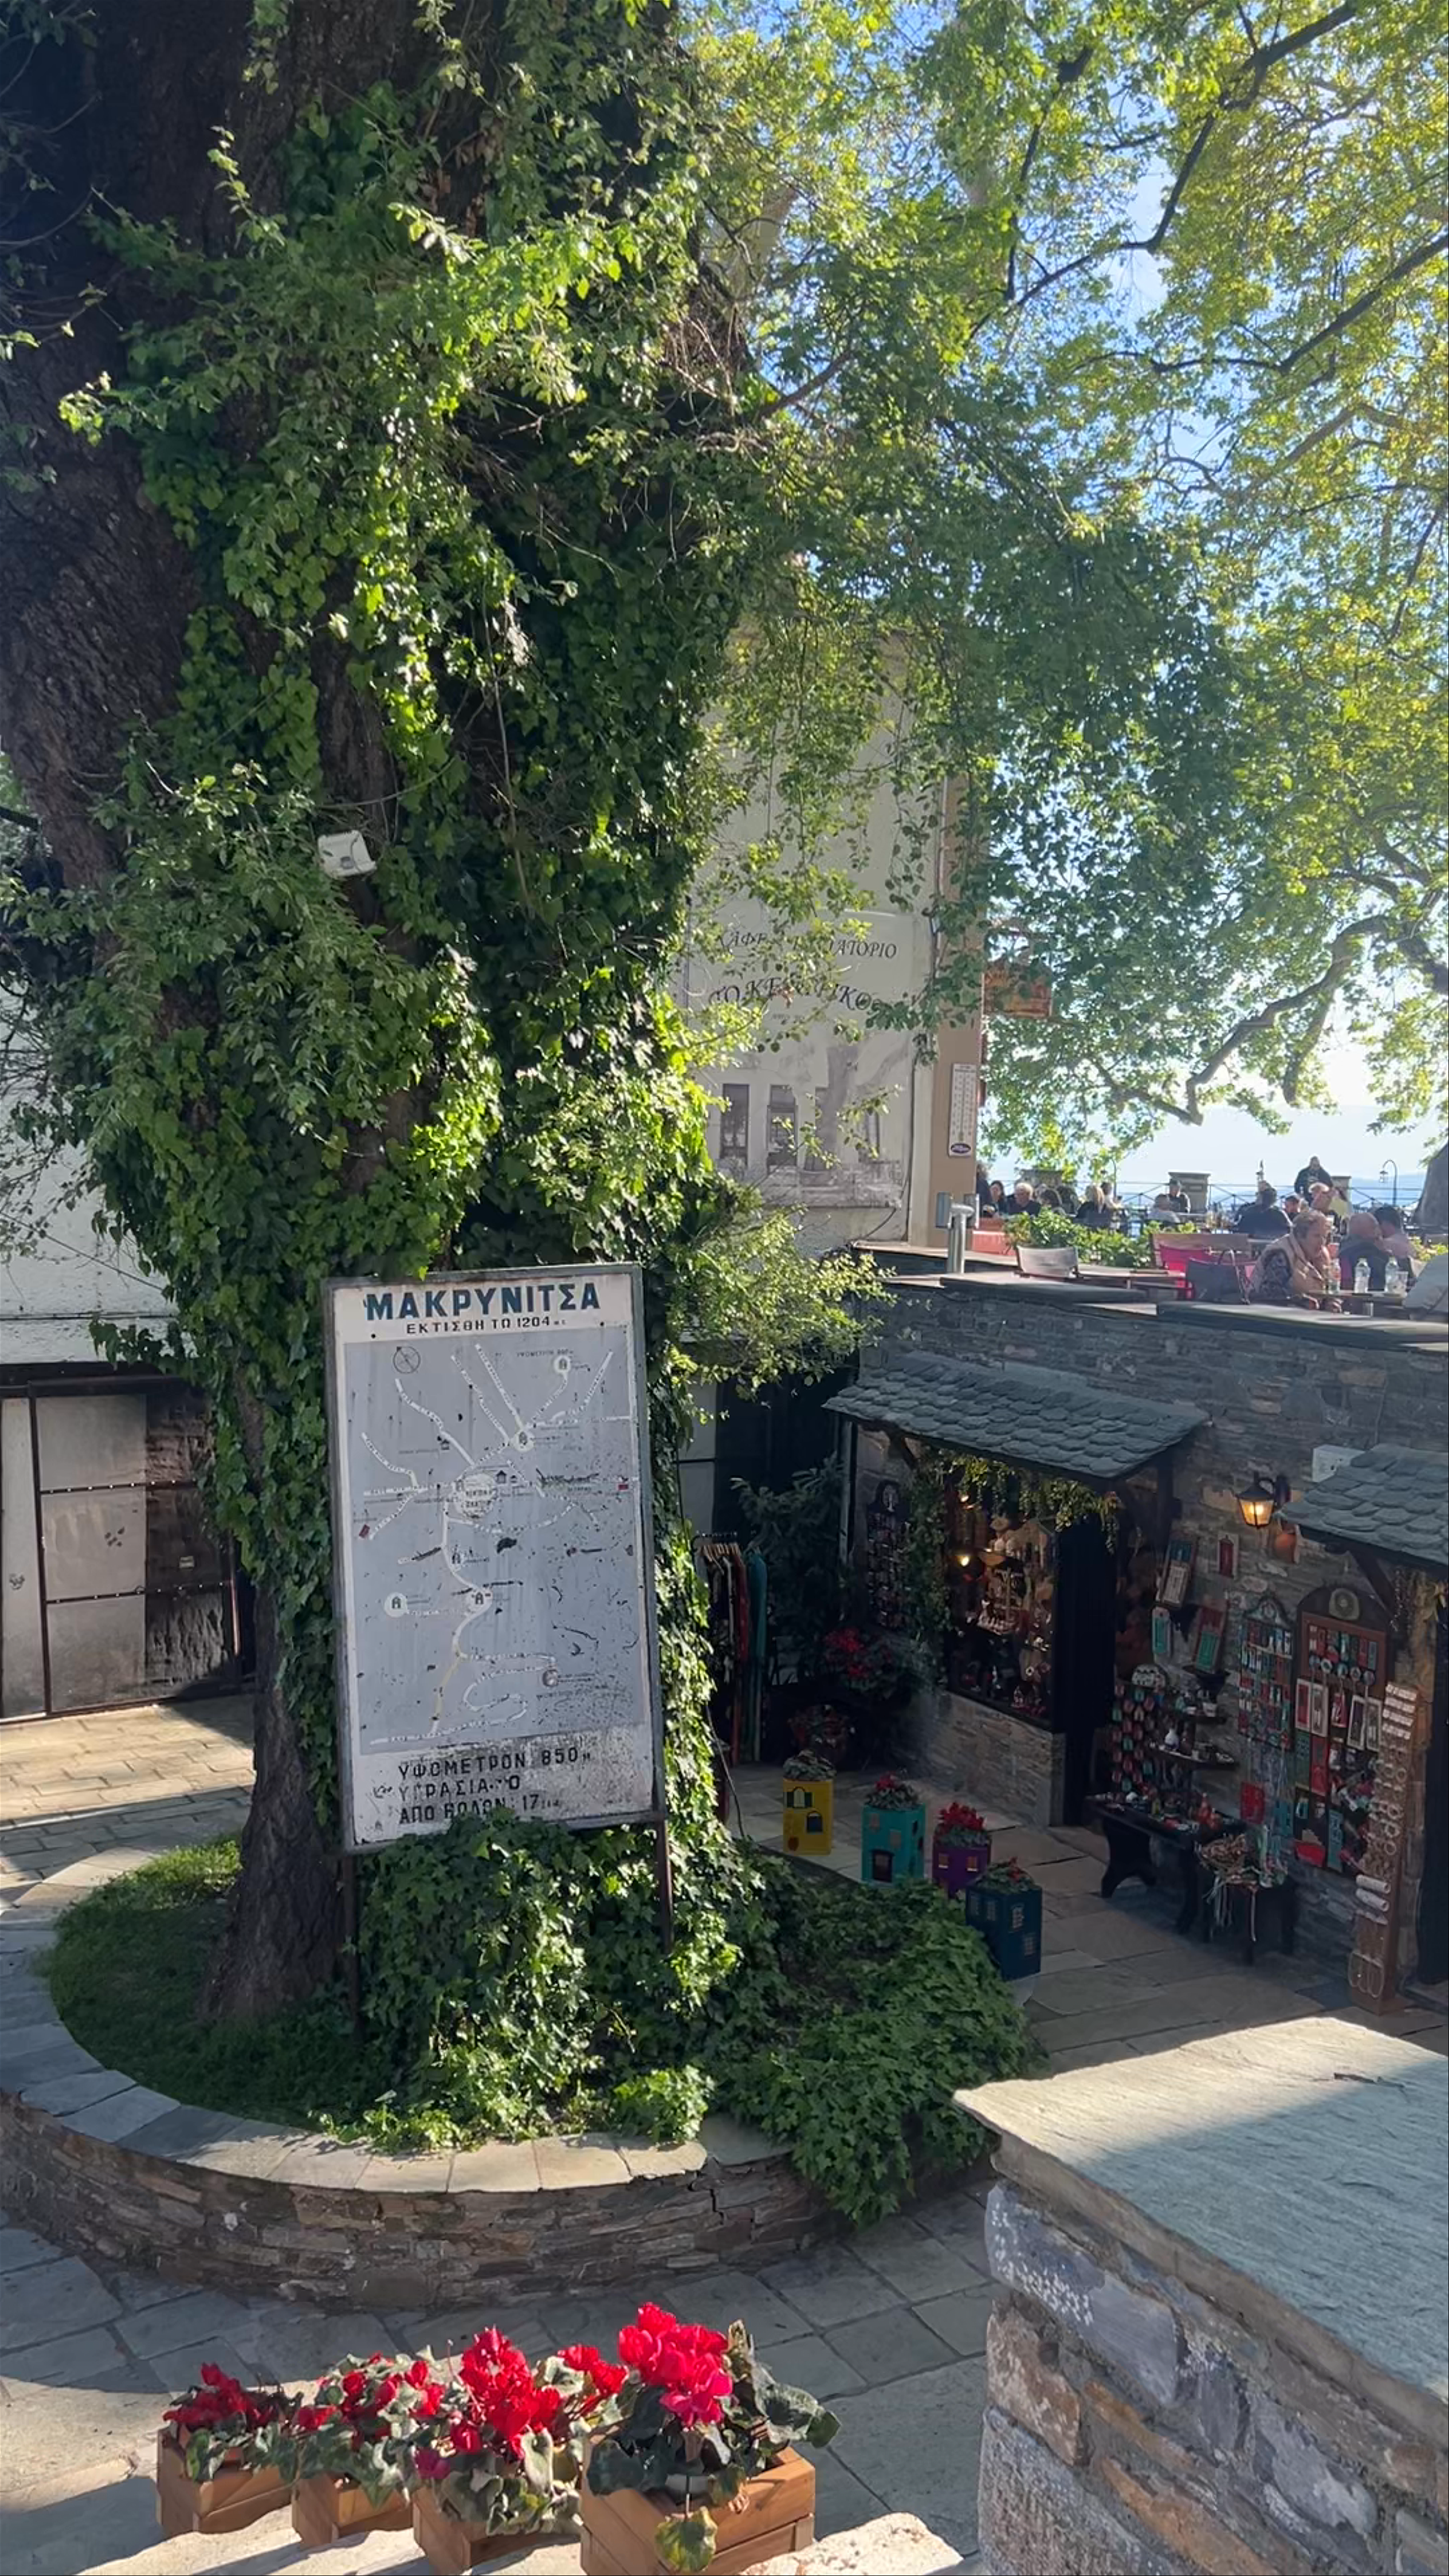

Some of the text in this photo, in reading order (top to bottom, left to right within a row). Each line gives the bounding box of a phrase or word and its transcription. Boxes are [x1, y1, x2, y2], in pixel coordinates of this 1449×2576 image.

[367, 1283, 600, 1320] ΜΑΚΡΥΝΙΤΣΑ
[407, 1320, 485, 1334] ΕΚΤΙΣΘΗ
[517, 1316, 550, 1328] 1204
[399, 1806, 435, 1824] ΑΠΟ
